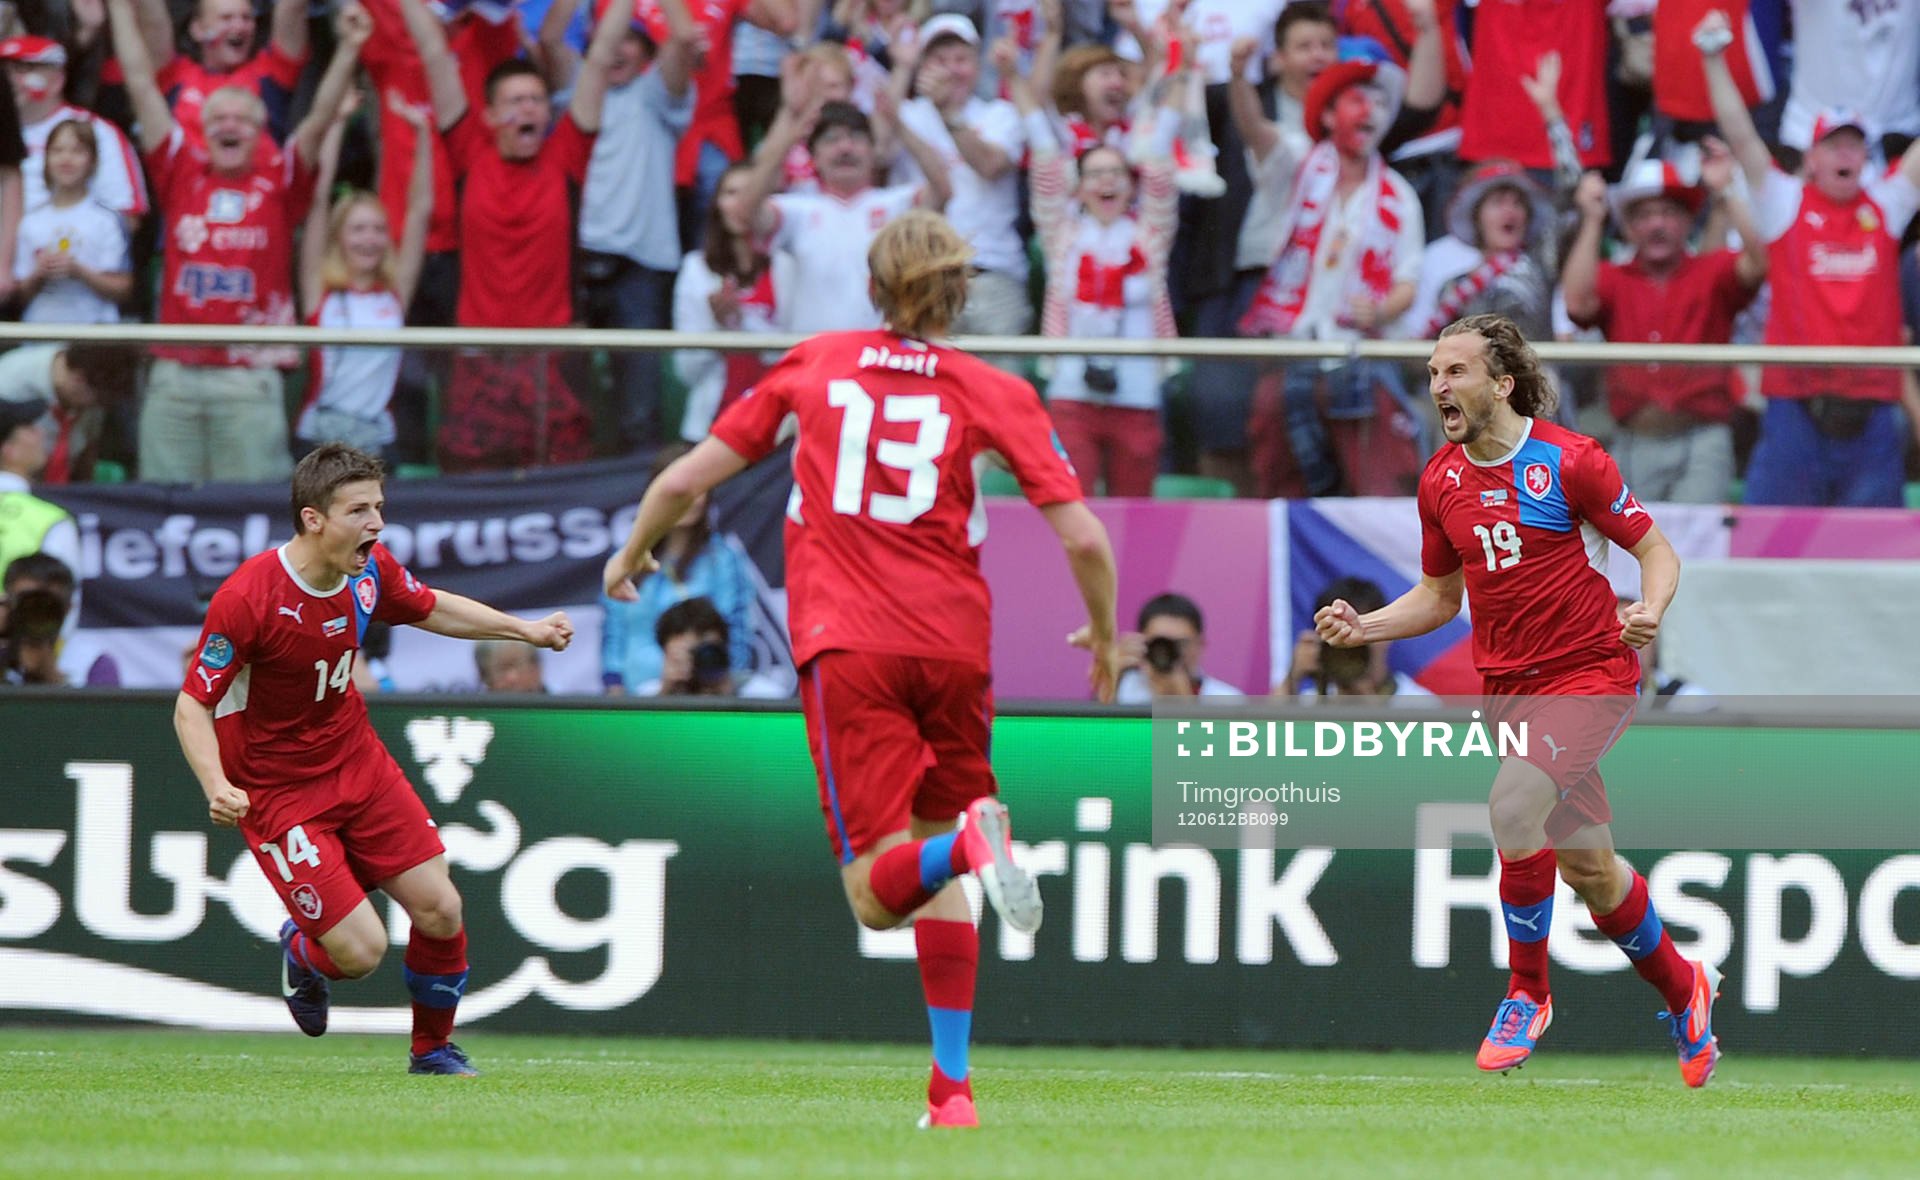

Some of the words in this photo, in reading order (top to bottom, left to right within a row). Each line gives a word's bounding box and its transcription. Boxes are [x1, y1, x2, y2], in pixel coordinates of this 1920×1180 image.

[828, 379, 951, 525] 13
[1473, 521, 1523, 572] 19
[315, 650, 352, 702] 14
[259, 825, 321, 883] 14
[858, 797, 1340, 966] rink
